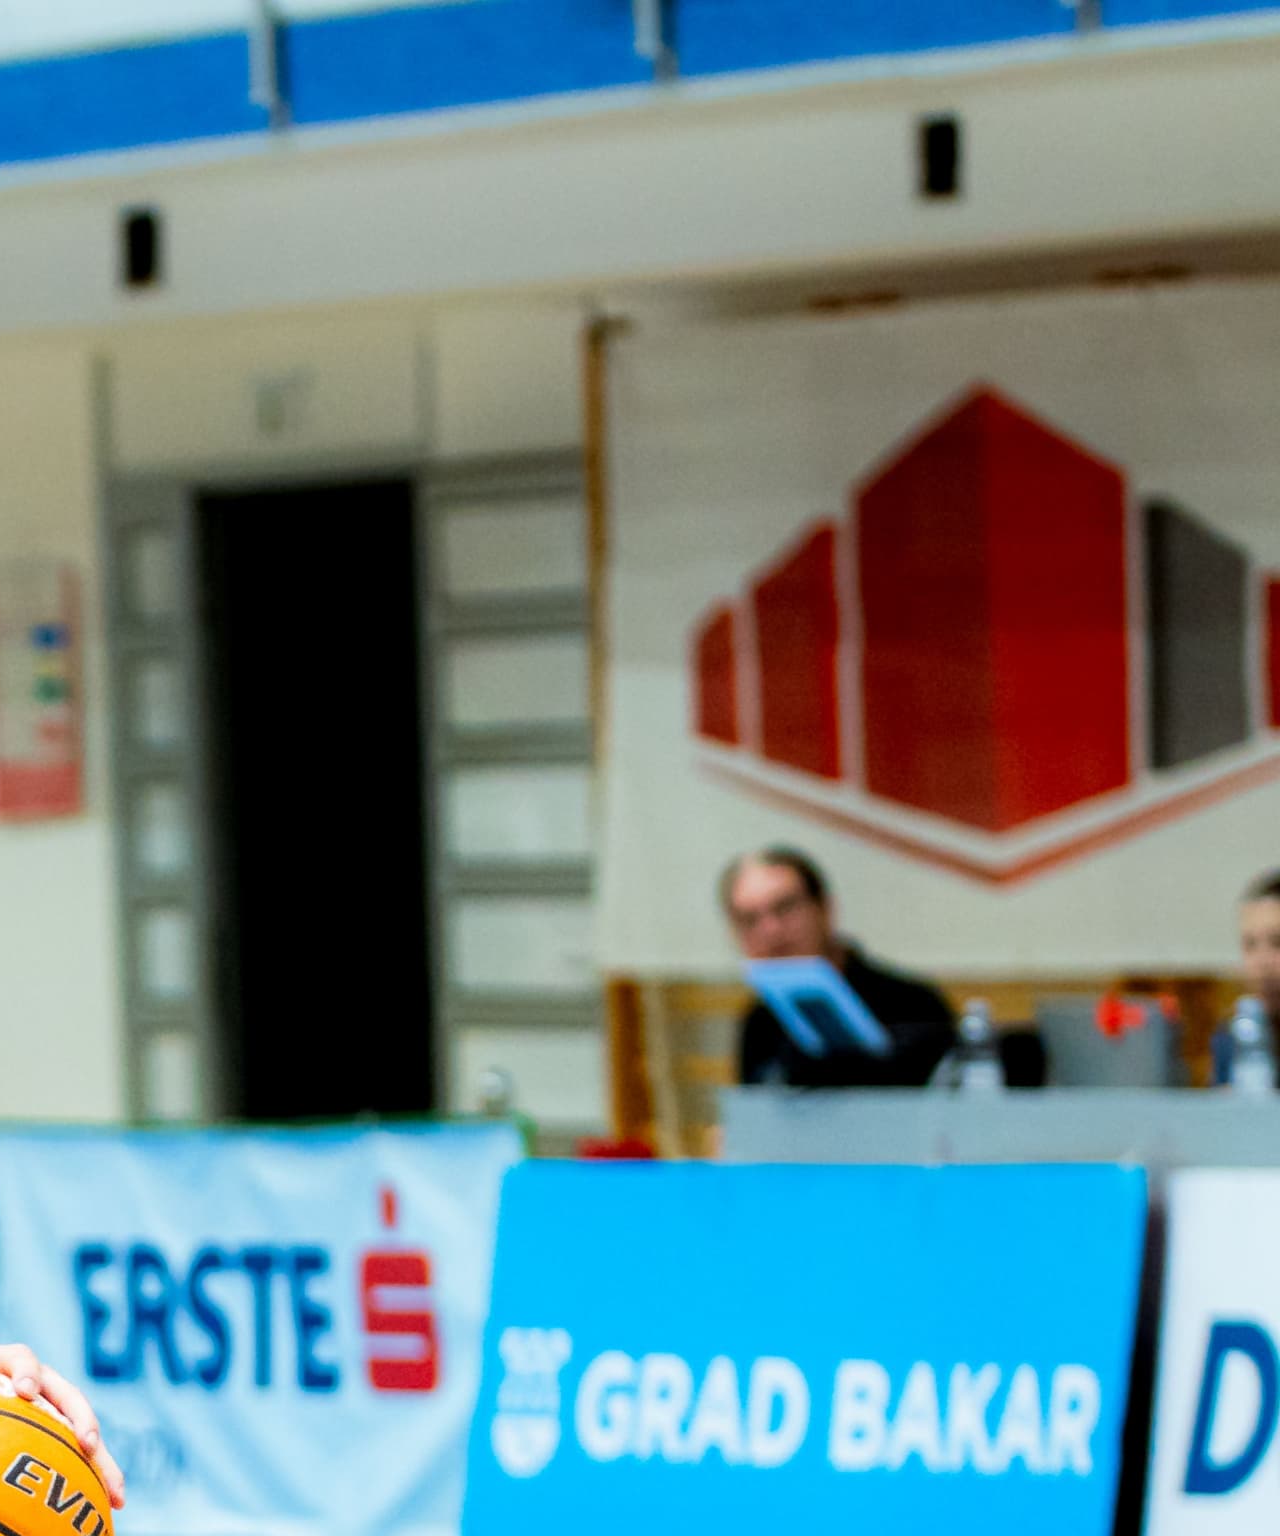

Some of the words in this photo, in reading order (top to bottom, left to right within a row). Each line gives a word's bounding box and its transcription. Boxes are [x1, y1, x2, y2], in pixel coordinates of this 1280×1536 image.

[73, 1242, 339, 1393] ERSTE
[574, 1349, 811, 1467] GRAD
[828, 1359, 1101, 1476] BAKAR
